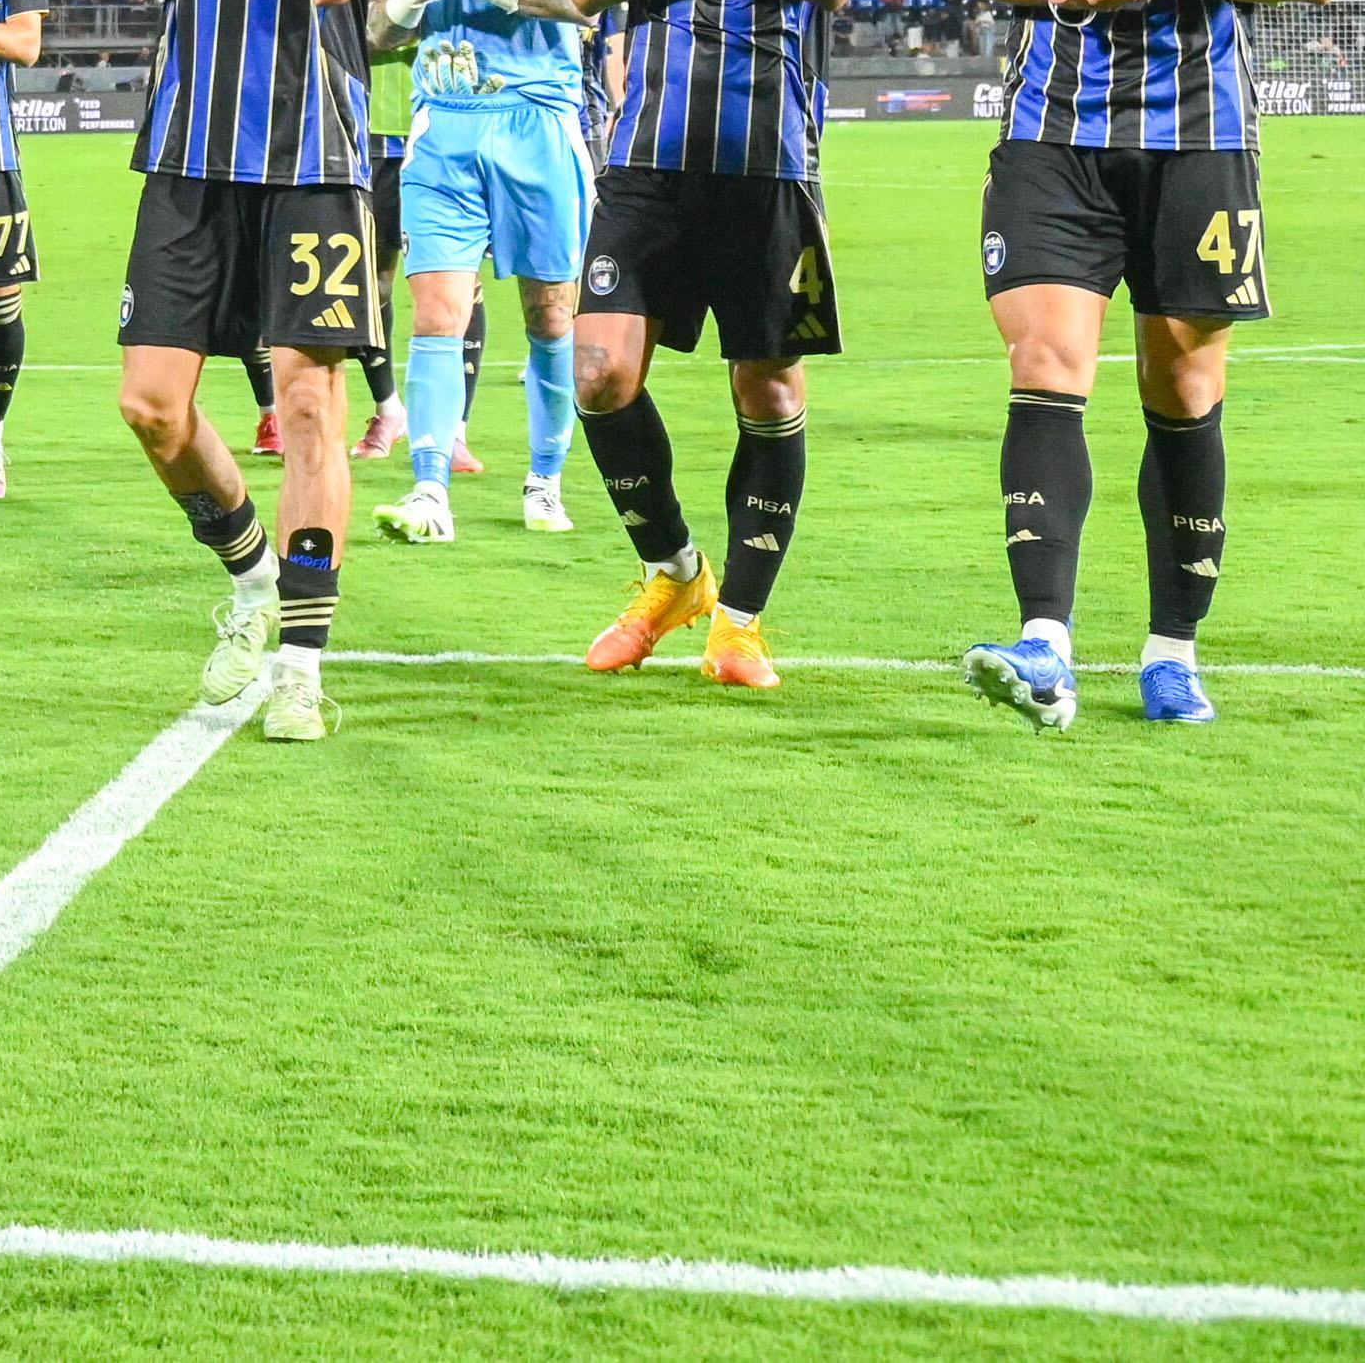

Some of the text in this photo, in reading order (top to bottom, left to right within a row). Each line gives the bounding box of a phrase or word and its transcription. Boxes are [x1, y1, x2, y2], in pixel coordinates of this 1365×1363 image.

[12, 99, 66, 117] etilar
[79, 99, 101, 110] FEED
[15, 117, 67, 132] RITION
[1195, 209, 1261, 275] 47
[289, 232, 362, 297] 32
[788, 246, 823, 305] 4
[746, 495, 792, 516] PISA
[1172, 514, 1224, 534] PISA
